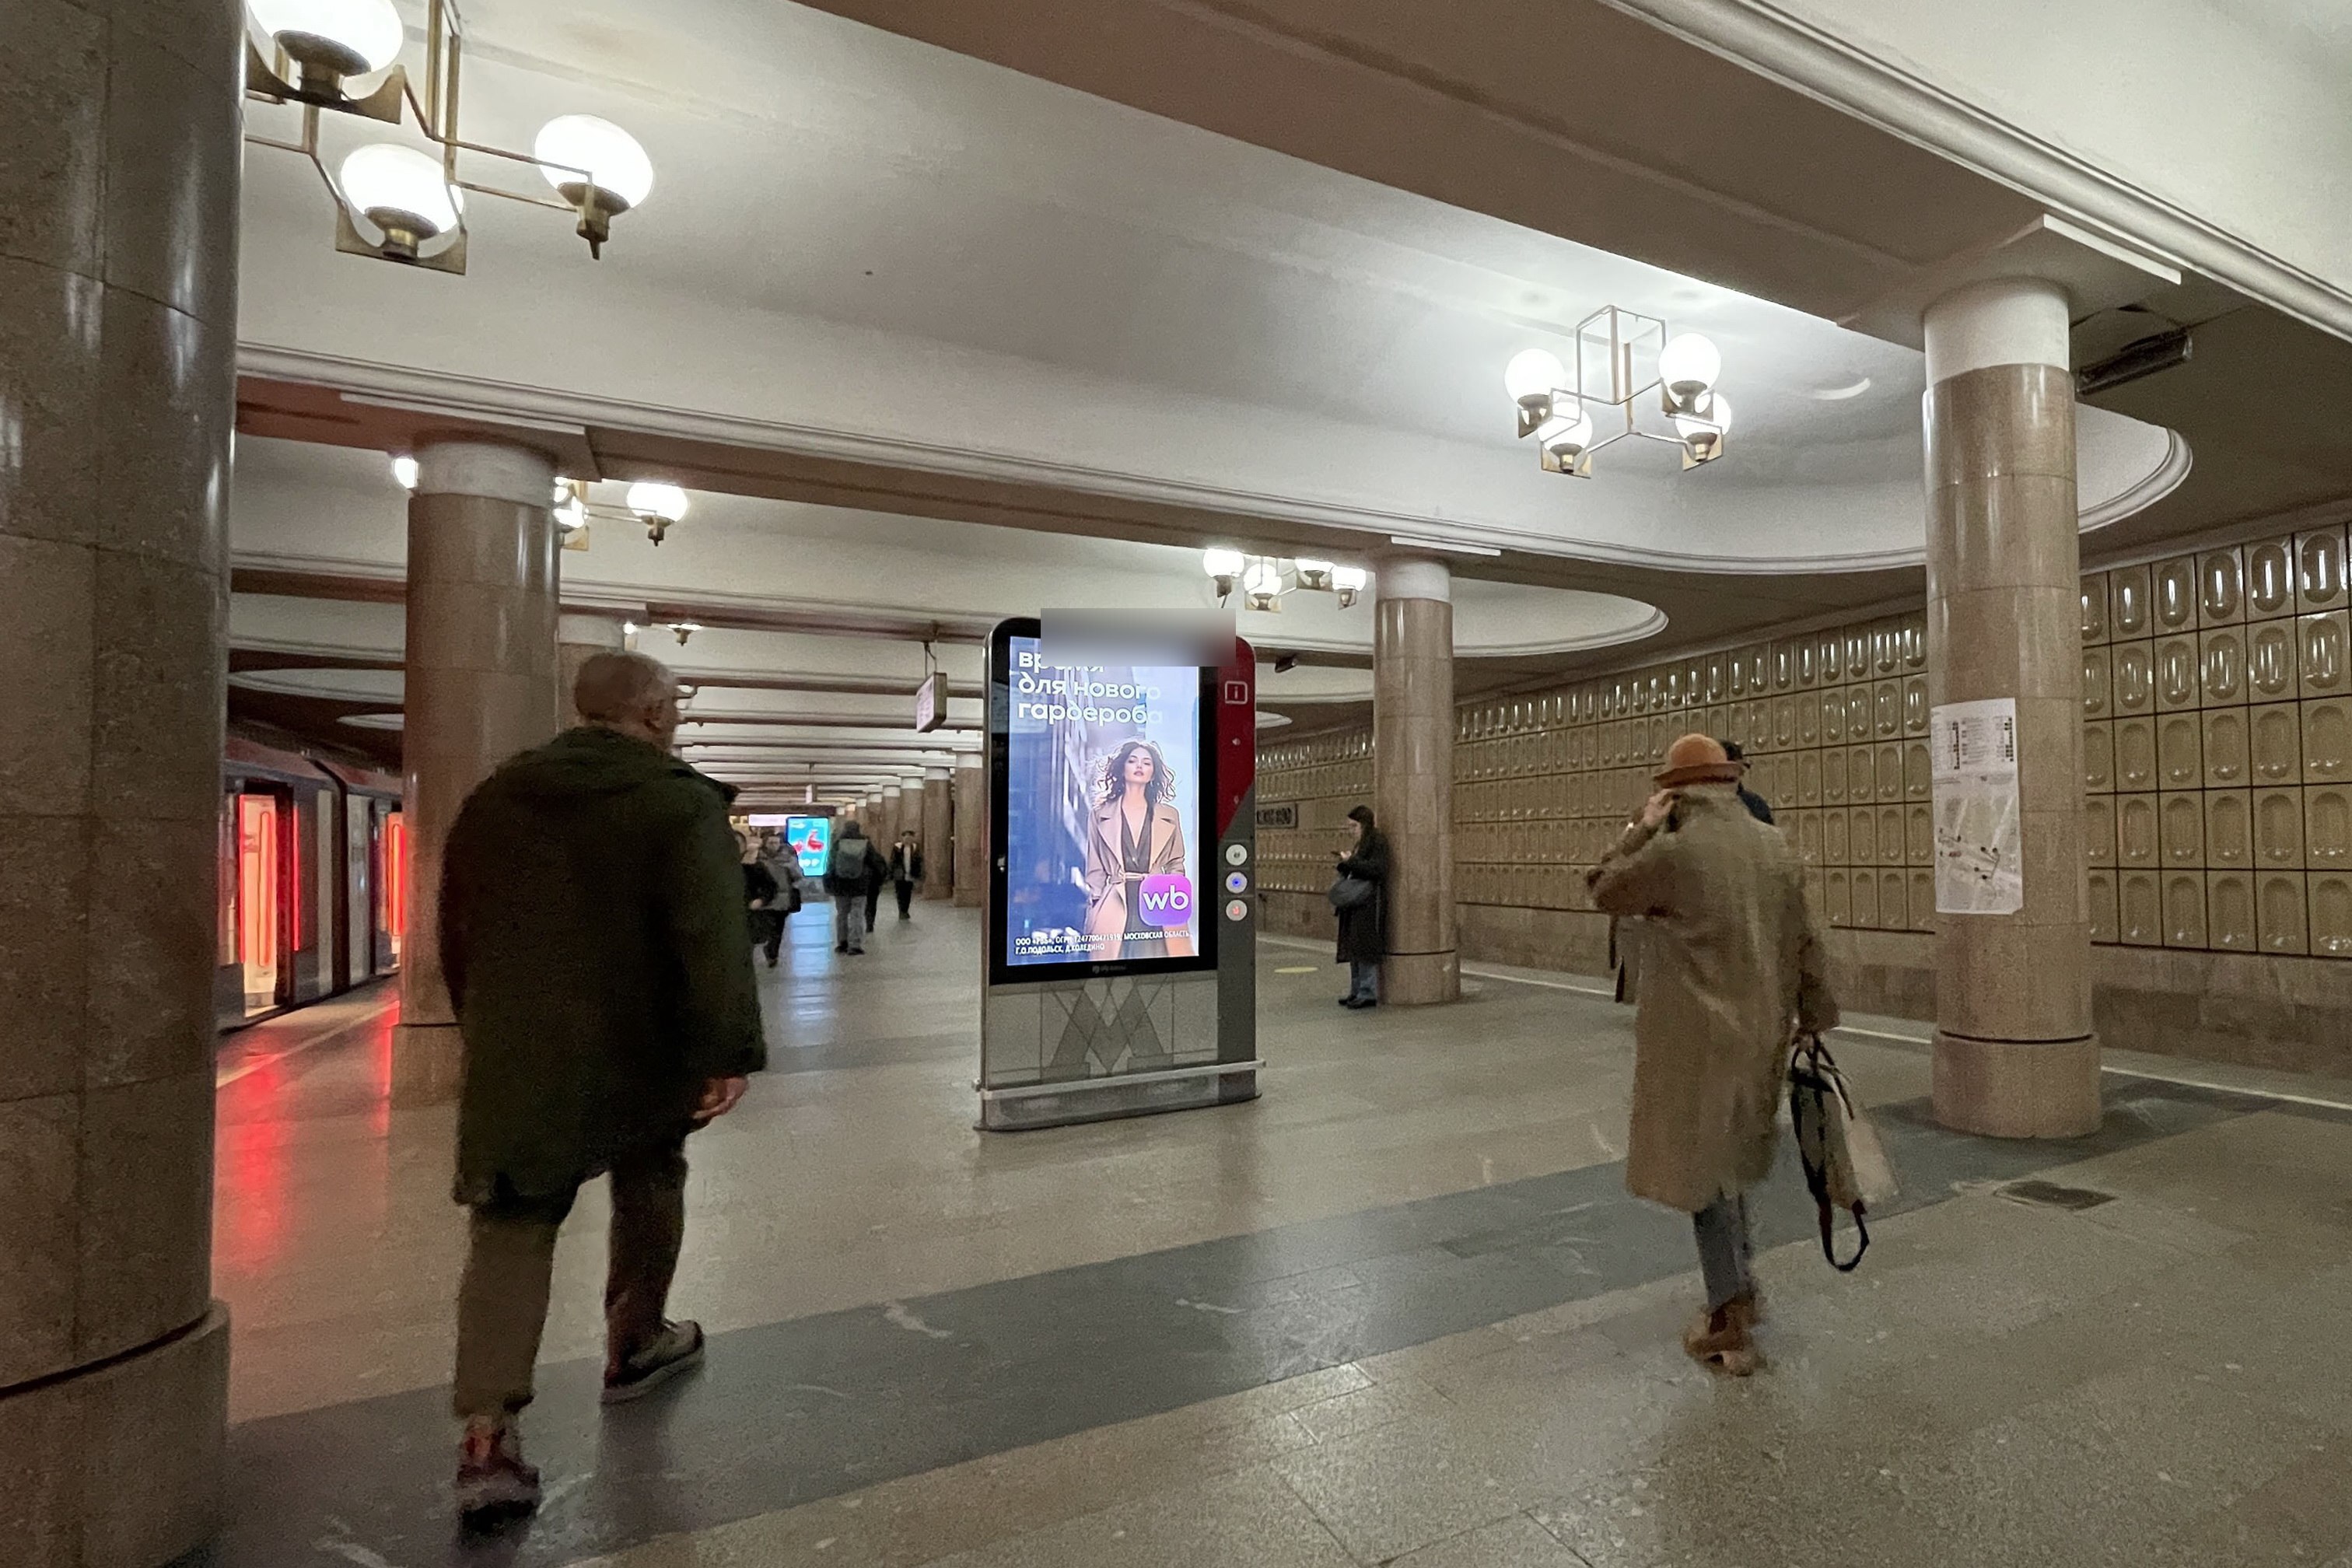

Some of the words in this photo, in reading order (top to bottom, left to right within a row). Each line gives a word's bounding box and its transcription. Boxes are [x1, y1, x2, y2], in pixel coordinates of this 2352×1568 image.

[1018, 671, 1066, 695] для
[1074, 681, 1160, 700] нового
[1018, 701, 1163, 726] гардероба
[1143, 885, 1189, 910] wb
[1015, 937, 1031, 946] ООО
